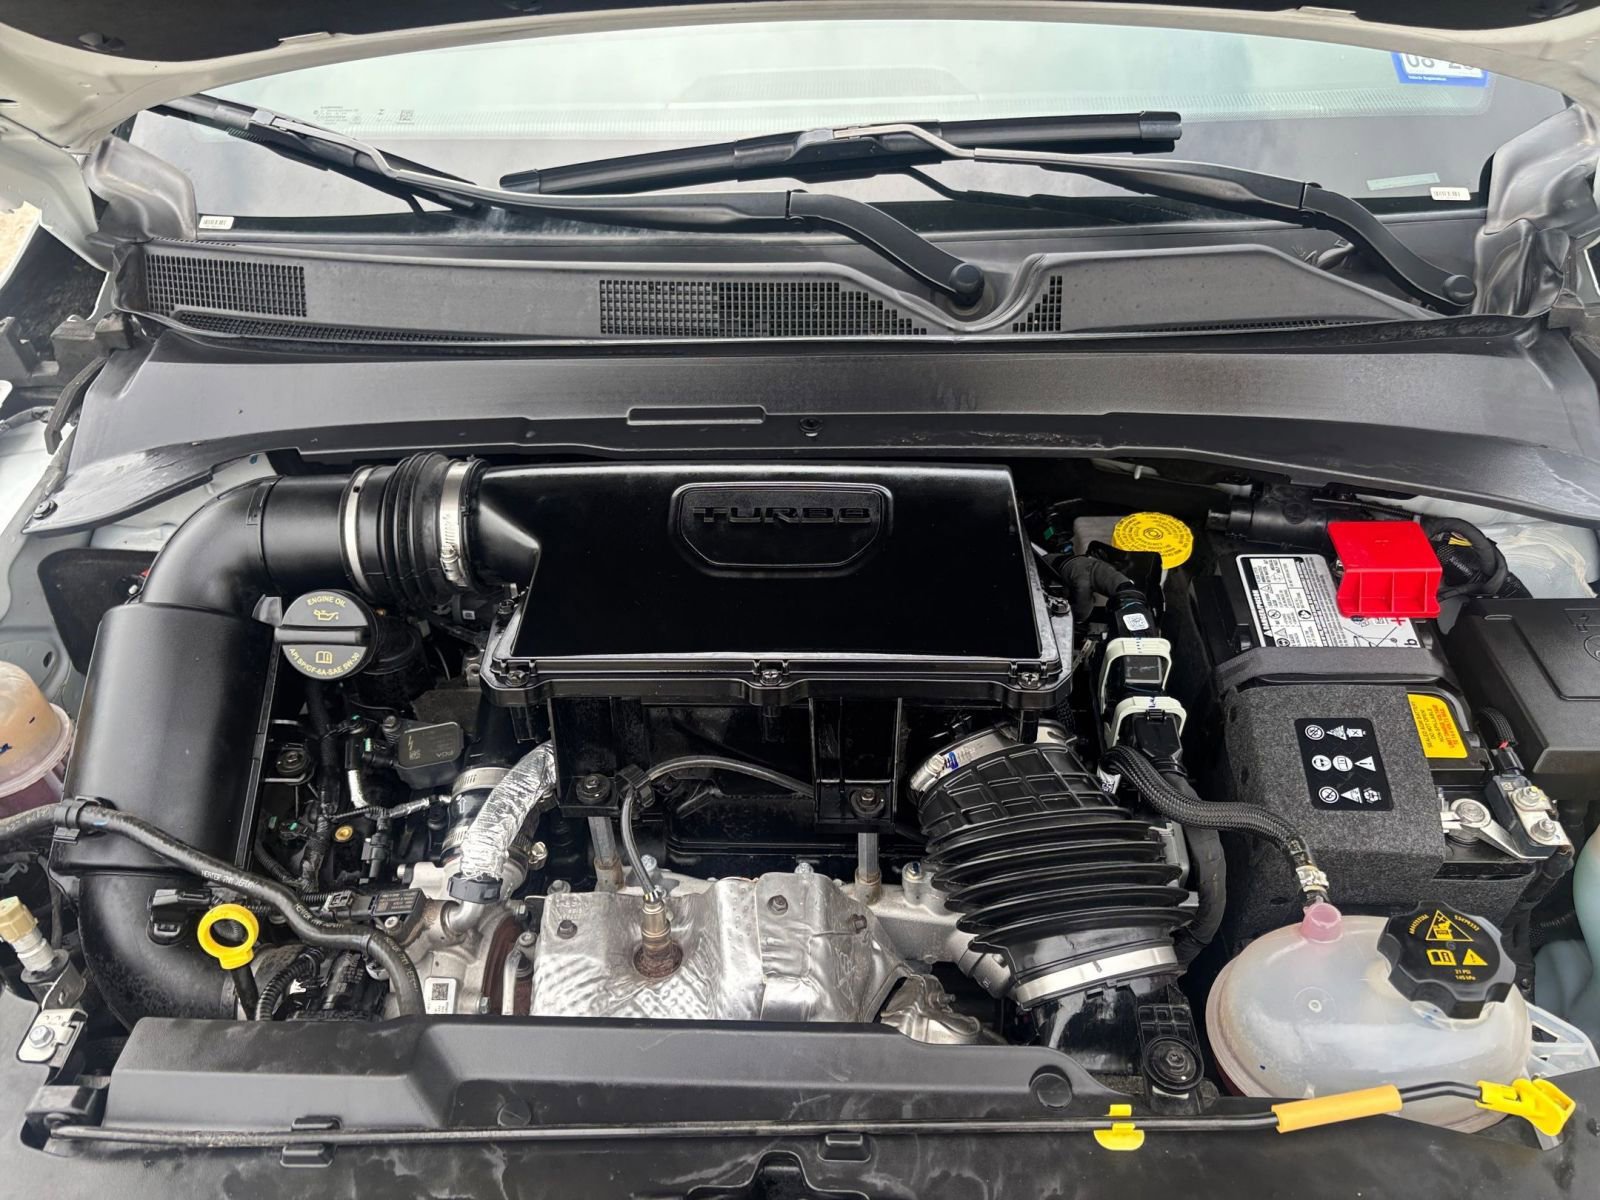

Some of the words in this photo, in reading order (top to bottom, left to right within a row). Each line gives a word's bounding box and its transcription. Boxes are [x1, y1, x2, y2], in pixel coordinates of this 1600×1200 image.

[307, 595, 334, 606] ENGINE
[335, 598, 347, 608] OIL
[289, 648, 300, 660] API
